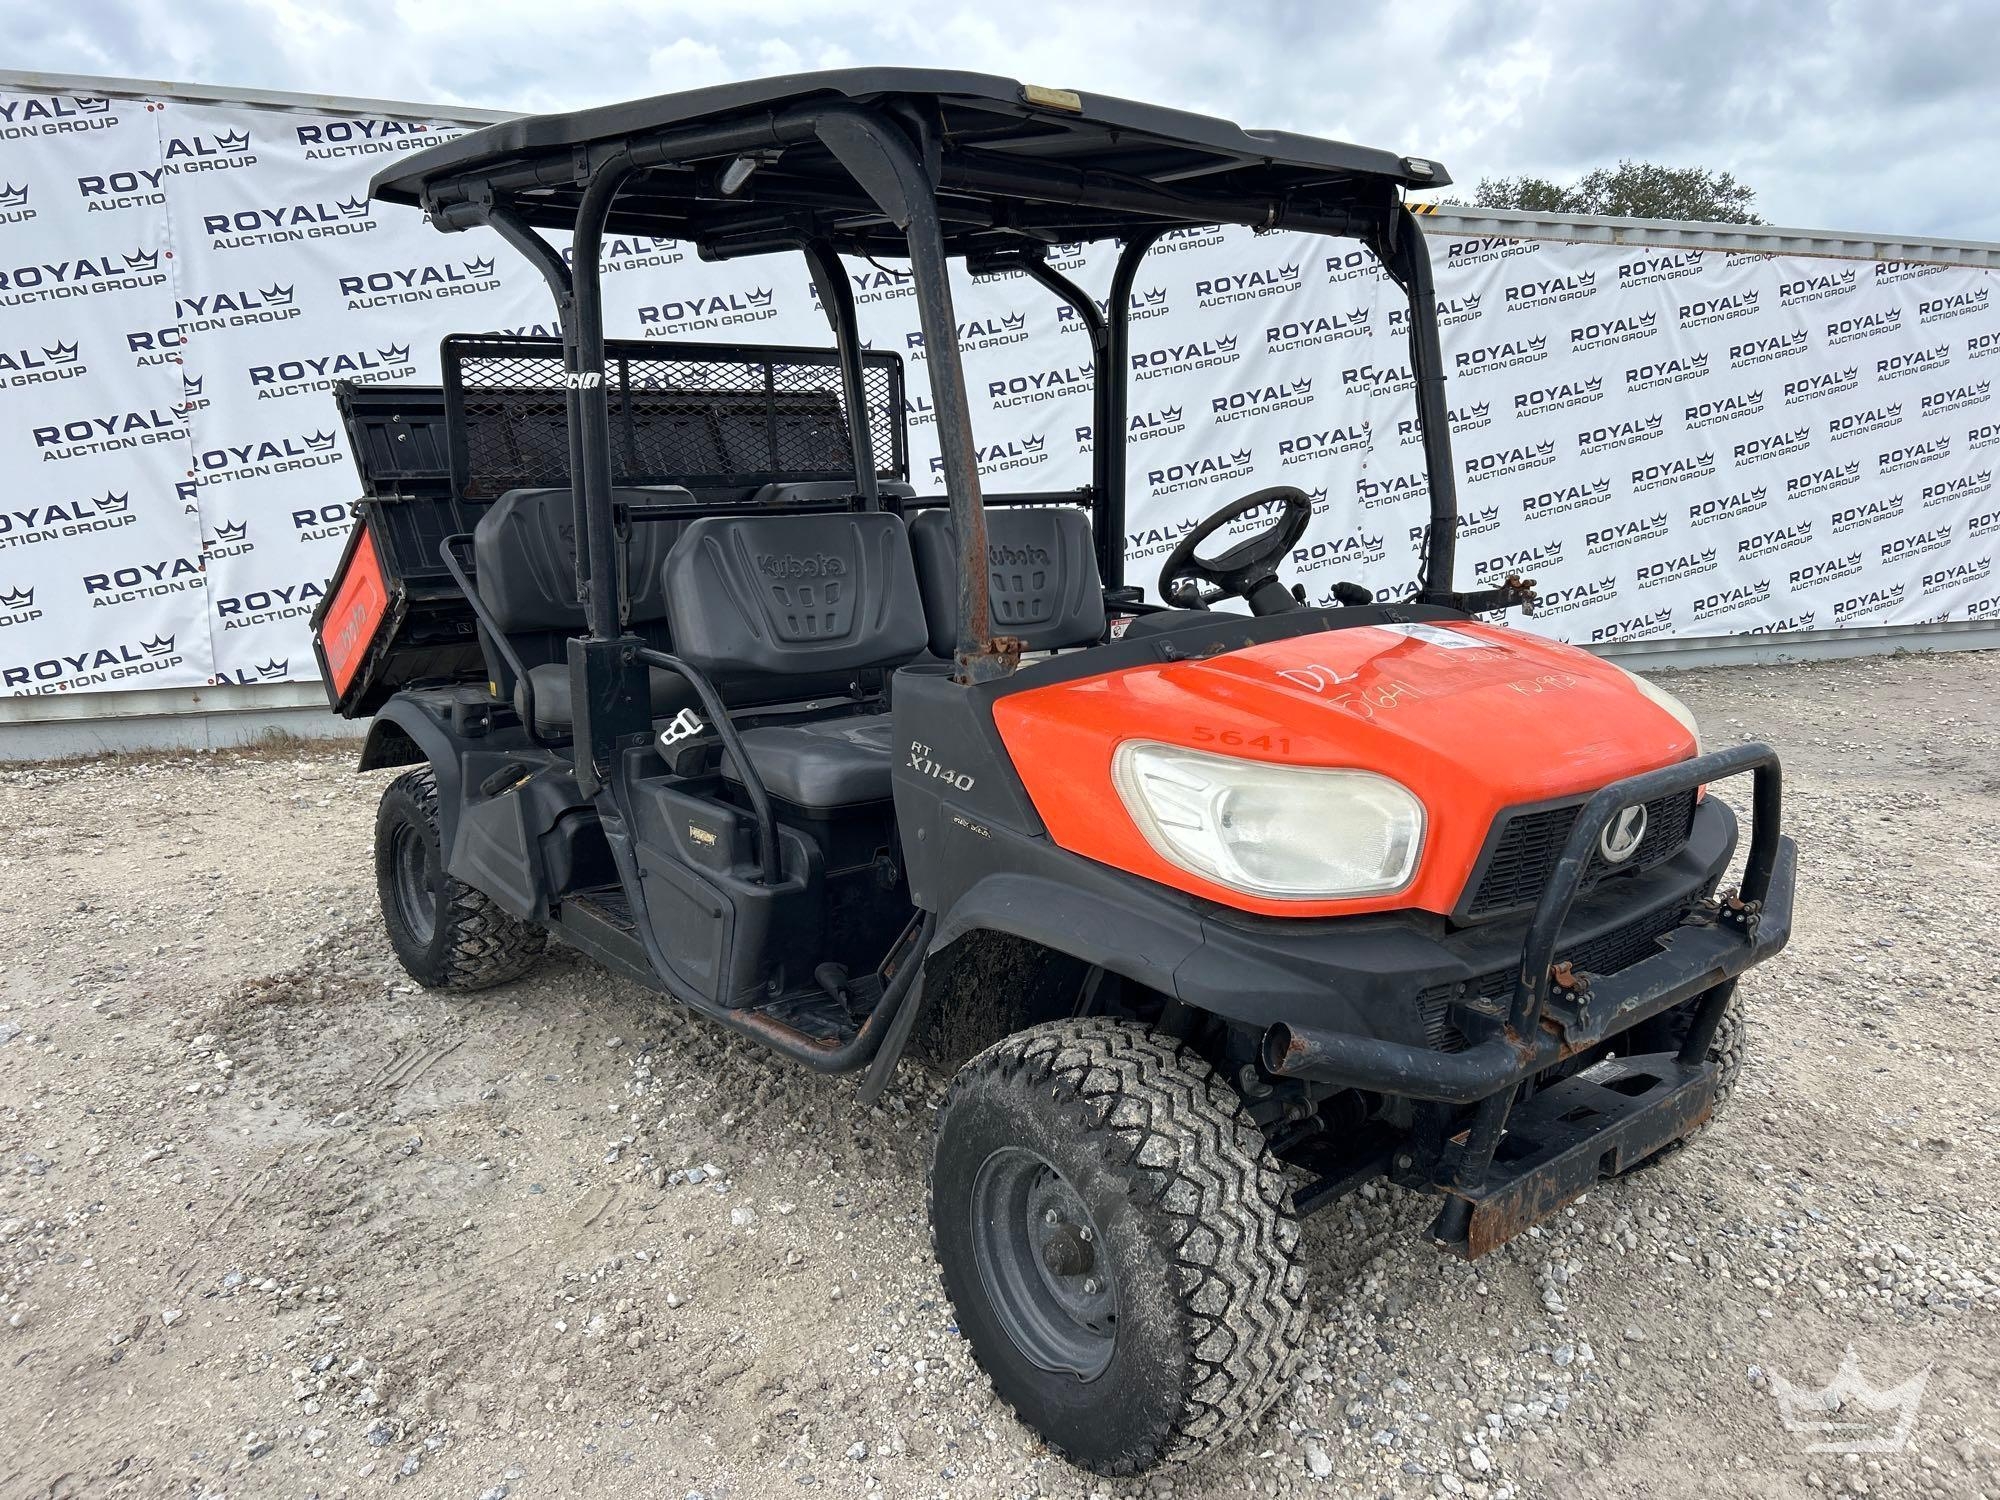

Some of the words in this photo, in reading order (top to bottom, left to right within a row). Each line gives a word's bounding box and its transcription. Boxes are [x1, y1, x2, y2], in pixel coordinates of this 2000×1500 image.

[41, 116, 118, 134] GROUP
[185, 155, 257, 173] GROUP
[305, 141, 393, 160] AUCTION
[203, 203, 339, 235] ROYAL
[213, 229, 304, 250] AUCTION
[307, 220, 377, 238] GROUP
[1447, 251, 1498, 269] AUCTION
[1500, 243, 1539, 258] GROUP
[1617, 254, 1685, 279] ROYAL
[92, 274, 167, 293] GROUP
[338, 263, 465, 296] ROYAL
[1195, 269, 1279, 297] ROYAL
[1504, 276, 1577, 302] ROYAL
[1619, 273, 1666, 289] AUCTION
[1667, 266, 1702, 279] GROUP
[1779, 274, 1840, 297] ROYAL
[347, 289, 433, 310] AUCTION
[435, 279, 501, 297] GROUP
[1198, 290, 1256, 308] AUCTION
[1257, 281, 1301, 297] GROUP
[1506, 295, 1557, 312] AUCTION
[1558, 287, 1597, 302] GROUP
[1678, 294, 1742, 320] ROYAL
[1780, 291, 1823, 307] AUCTION
[1824, 284, 1856, 297] GROUP
[1919, 292, 1974, 315] ROYAL
[230, 308, 301, 326] GROUP
[637, 294, 747, 324] ROYAL
[1680, 313, 1724, 330] AUCTION
[1725, 305, 1759, 319] GROUP
[1919, 309, 1958, 324] AUCTION
[1959, 302, 1988, 315] GROUP
[644, 317, 718, 338] AUCTION
[720, 308, 777, 325] GROUP
[1264, 315, 1344, 343] ROYAL
[1570, 317, 1639, 343] ROYAL
[1826, 313, 1884, 337] ROYAL
[1827, 330, 1868, 346] AUCTION
[1869, 322, 1900, 336] GROUP
[1267, 335, 1322, 354] AUCTION
[1324, 326, 1371, 342] GROUP
[1455, 340, 1528, 367] ROYAL
[1572, 335, 1619, 353] AUCTION
[1621, 327, 1657, 342] GROUP
[1728, 334, 1791, 359] ROYAL
[248, 351, 380, 386] ROYAL
[1130, 341, 1216, 370] ROYAL
[1134, 362, 1193, 381] AUCTION
[1194, 353, 1239, 369] GROUP
[1457, 360, 1507, 378] AUCTION
[1509, 351, 1547, 366] GROUP
[1730, 352, 1773, 369] AUCTION
[1774, 344, 1807, 359] GROUP
[1876, 349, 1935, 373] ROYAL
[12, 365, 87, 386] GROUP
[257, 377, 346, 400] AUCTION
[349, 366, 416, 385] GROUP
[988, 368, 1079, 398] ROYAL
[1625, 357, 1691, 383] ROYAL
[1626, 376, 1672, 393] AUCTION
[1673, 368, 1709, 382] GROUP
[1783, 371, 1843, 396] ROYAL
[1877, 366, 1918, 382] AUCTION
[1919, 358, 1950, 372] GROUP
[992, 389, 1055, 410] AUCTION
[1211, 384, 1292, 413] ROYAL
[1513, 381, 1584, 408] ROYAL
[1515, 401, 1564, 419] AUCTION
[1566, 392, 1603, 407] GROUP
[1784, 389, 1826, 406] AUCTION
[1827, 381, 1858, 395] GROUP
[1921, 385, 1976, 409] ROYAL
[1921, 401, 1960, 418] AUCTION
[1961, 394, 1990, 407] GROUP
[1214, 404, 1270, 424] AUCTION
[1271, 394, 1314, 411] GROUP
[1684, 395, 1747, 421] ROYAL
[1686, 413, 1729, 430] AUCTION
[1730, 404, 1763, 419] GROUP
[32, 409, 173, 447] ROYAL
[1276, 425, 1361, 455] ROYAL
[1577, 419, 1645, 446] ROYAL
[43, 436, 138, 462] AUCTION
[1280, 446, 1338, 466] AUCTION
[1579, 438, 1626, 456] AUCTION
[1627, 429, 1663, 444] GROUP
[1733, 432, 1794, 458] ROYAL
[1734, 450, 1776, 467] AUCTION
[1777, 441, 1810, 456] GROUP
[273, 452, 342, 472] GROUP
[1147, 455, 1231, 486] ROYAL
[1464, 445, 1536, 473] ROYAL
[1466, 465, 1516, 484] AUCTION
[1517, 455, 1555, 471] GROUP
[1630, 457, 1696, 484] ROYAL
[1151, 476, 1208, 497] AUCTION
[1210, 465, 1254, 483] GROUP
[1632, 475, 1678, 493] AUCTION
[1679, 466, 1714, 481] GROUP
[1786, 466, 1844, 492] ROYAL
[1787, 483, 1827, 501] AUCTION
[1828, 474, 1859, 489] GROUP
[1922, 475, 1977, 499] ROYAL
[1522, 484, 1592, 511] ROYAL
[1524, 502, 1572, 521] AUCTION
[1573, 493, 1611, 508] GROUP
[1689, 492, 1751, 518] ROYAL
[1922, 491, 1961, 508] AUCTION
[1962, 483, 1991, 497] GROUP
[61, 514, 136, 536] GROUP
[1690, 510, 1733, 528] AUCTION
[1734, 500, 1767, 515] GROUP
[1585, 518, 1650, 546] ROYAL
[1587, 537, 1632, 556] AUCTION
[1633, 527, 1667, 543] GROUP
[1737, 526, 1796, 553] ROYAL
[1473, 547, 1544, 576] ROYAL
[1738, 544, 1779, 562] AUCTION
[1780, 534, 1812, 549] GROUP
[756, 553, 846, 578] Kubota
[1525, 555, 1563, 572] GROUP
[1636, 553, 1700, 581] ROYAL
[1637, 571, 1682, 590] AUCTION
[1683, 562, 1717, 577] GROUP
[1788, 557, 1847, 584] ROYAL
[1921, 562, 1976, 587] ROYAL
[1789, 574, 1830, 593] AUCTION
[1831, 565, 1862, 580] GROUP
[1922, 578, 1960, 596] AUCTION
[1961, 569, 1991, 584] GROUP
[92, 581, 185, 608] AUCTION
[1530, 582, 1599, 611] ROYAL
[1531, 601, 1579, 620] AUCTION
[1581, 590, 1617, 606] GROUP
[1693, 585, 1753, 612] ROYAL
[1693, 603, 1736, 621] AUCTION
[1737, 593, 1769, 608] GROUP
[224, 604, 312, 630] AUCTION
[1591, 614, 1655, 642] ROYAL
[1637, 621, 1671, 637] GROUP
[2, 644, 143, 687] ROYAL
[110, 655, 182, 679] GROUP
[911, 741, 932, 756] RT
[1192, 726, 1290, 754] 5641
[906, 753, 975, 792] X1140
